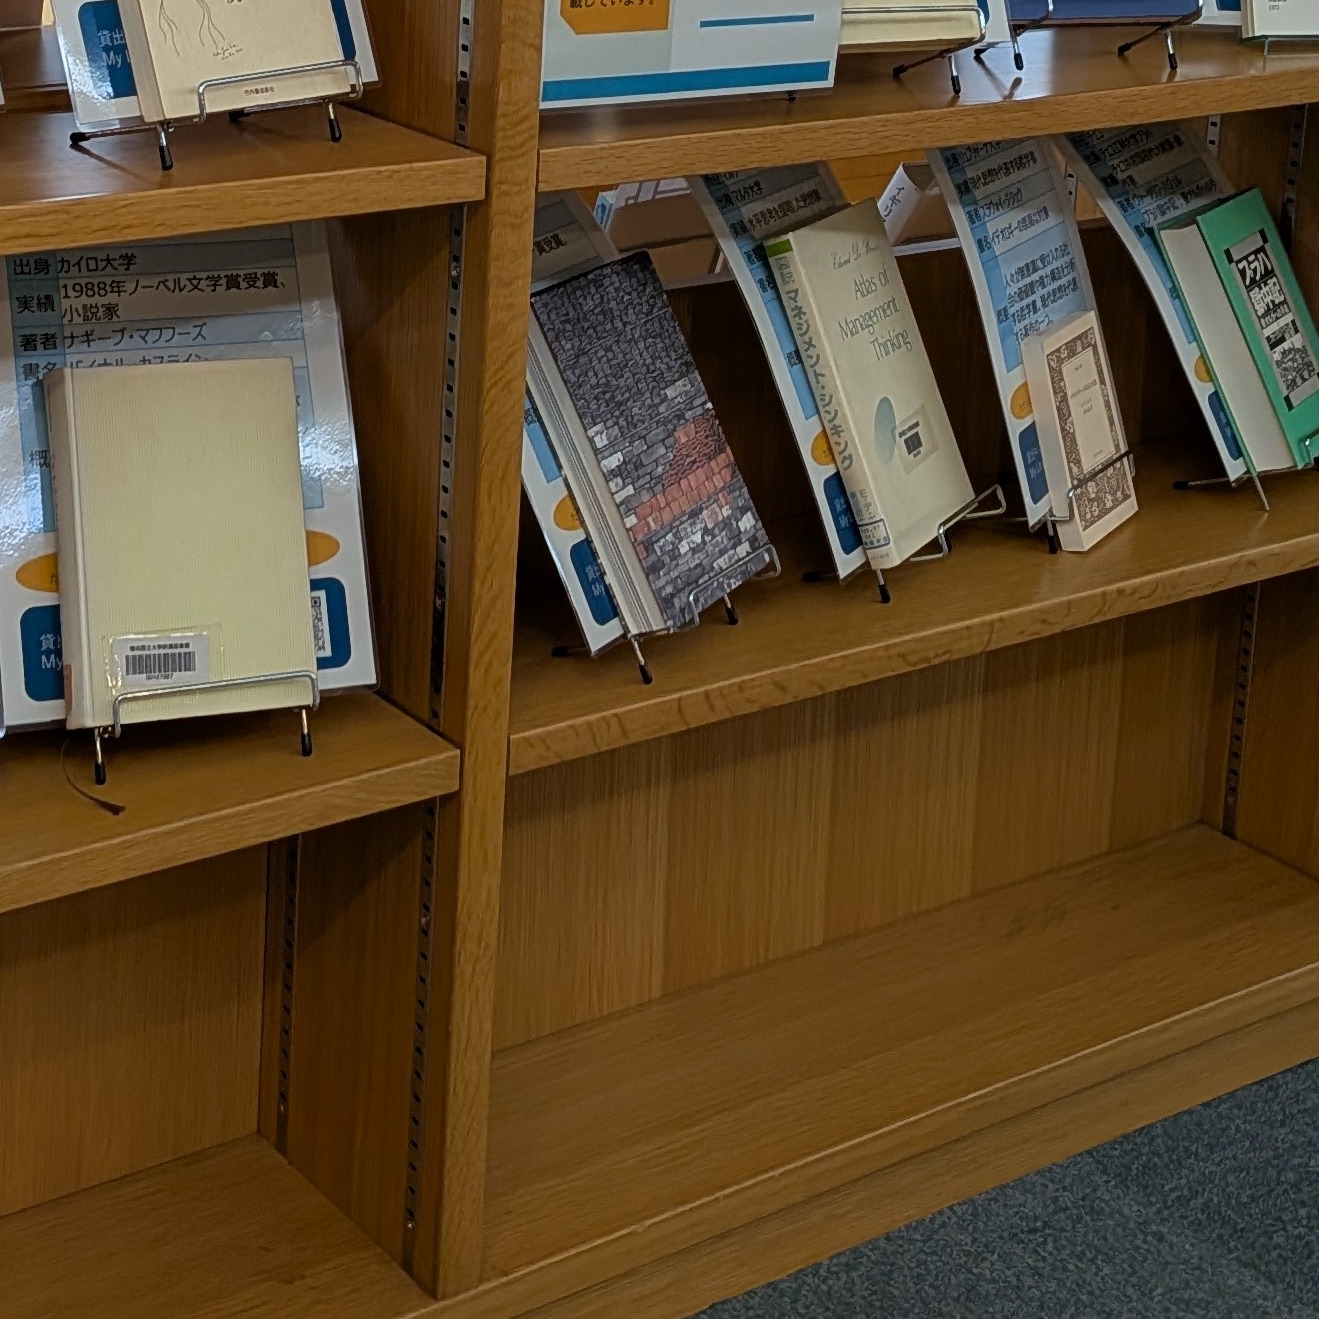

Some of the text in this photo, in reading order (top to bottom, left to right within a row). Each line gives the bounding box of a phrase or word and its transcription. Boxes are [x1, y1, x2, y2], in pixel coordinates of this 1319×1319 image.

[12, 253, 138, 277] 出身 カイロ大学
[853, 261, 890, 301] Atlas of
[1237, 251, 1272, 287] プラハ
[61, 270, 287, 299] 1988年ノーベル文学賞受賞、
[15, 294, 121, 323] 実績 小説家
[837, 293, 901, 342] Management
[19, 323, 208, 352] 著者 ナギーブ・マフフーズ
[869, 328, 914, 361] Thinking
[785, 288, 854, 472] マネジメント・シンキング
